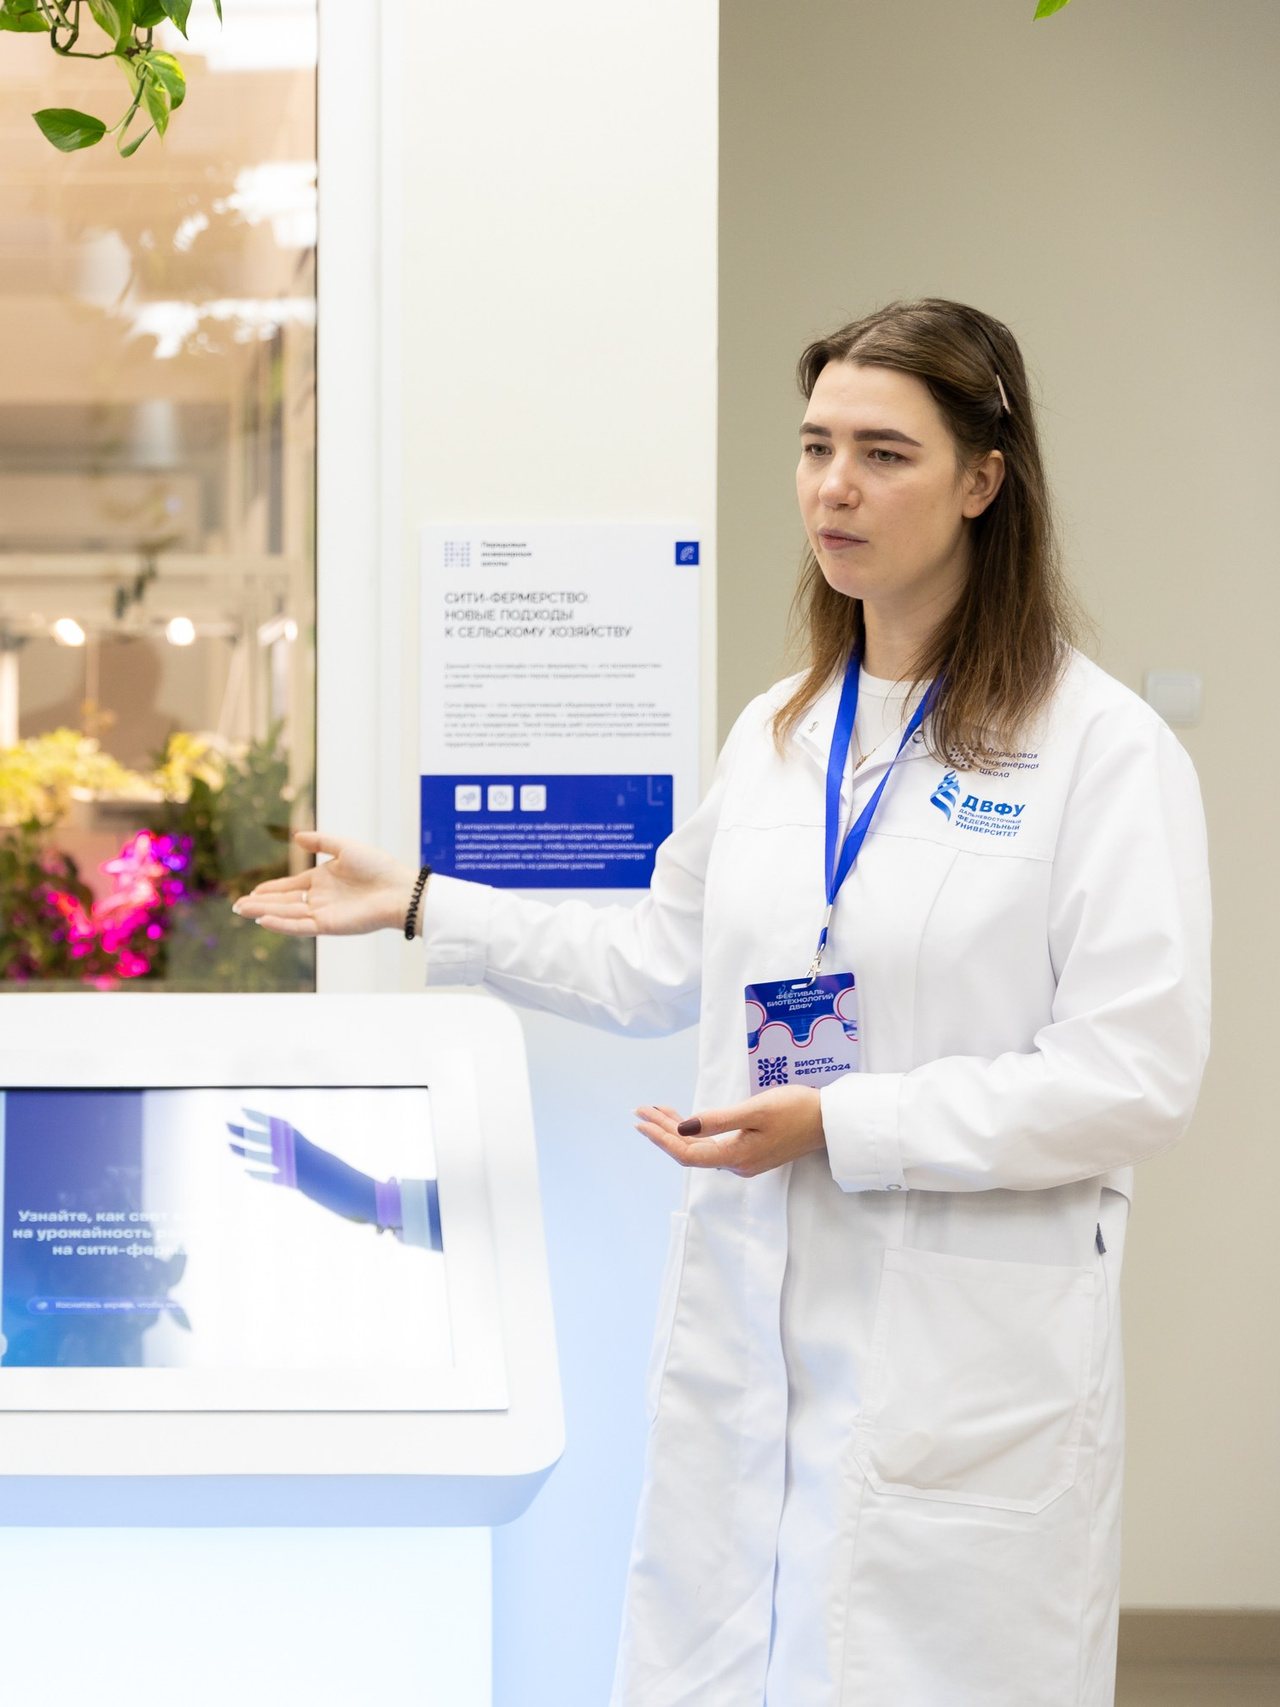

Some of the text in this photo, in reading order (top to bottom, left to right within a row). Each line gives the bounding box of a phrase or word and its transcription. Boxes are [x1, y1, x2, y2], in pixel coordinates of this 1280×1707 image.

[444, 592, 589, 604] СИТИ-ФЕРМЕРСТВО:
[444, 609, 574, 622] НОВЫЕ ПОДХОДЫ
[444, 624, 632, 639] К СЕЛЬСКОМУ ХОЗЯЙСТВУ
[986, 747, 1039, 760] Передовая
[979, 768, 1010, 778] школа
[961, 794, 1027, 818] ДВФУ
[954, 820, 1018, 837] УНИВЕРСИТЕТ
[957, 814, 1021, 830] ФЕДЕРАЛЬНЫЙ
[767, 993, 834, 1008] БИОТЕХНОЛОГИЙ
[776, 990, 825, 1000] ФЕСТИВАЛЬ
[794, 1057, 835, 1068] БИОТЕХ
[794, 1063, 851, 1076] ФЕСТ 2024
[18, 1210, 92, 1224] Узнайте,
[95, 1211, 125, 1222] как
[13, 1228, 33, 1239] на
[36, 1226, 152, 1241] урожайность
[52, 1245, 73, 1256] на
